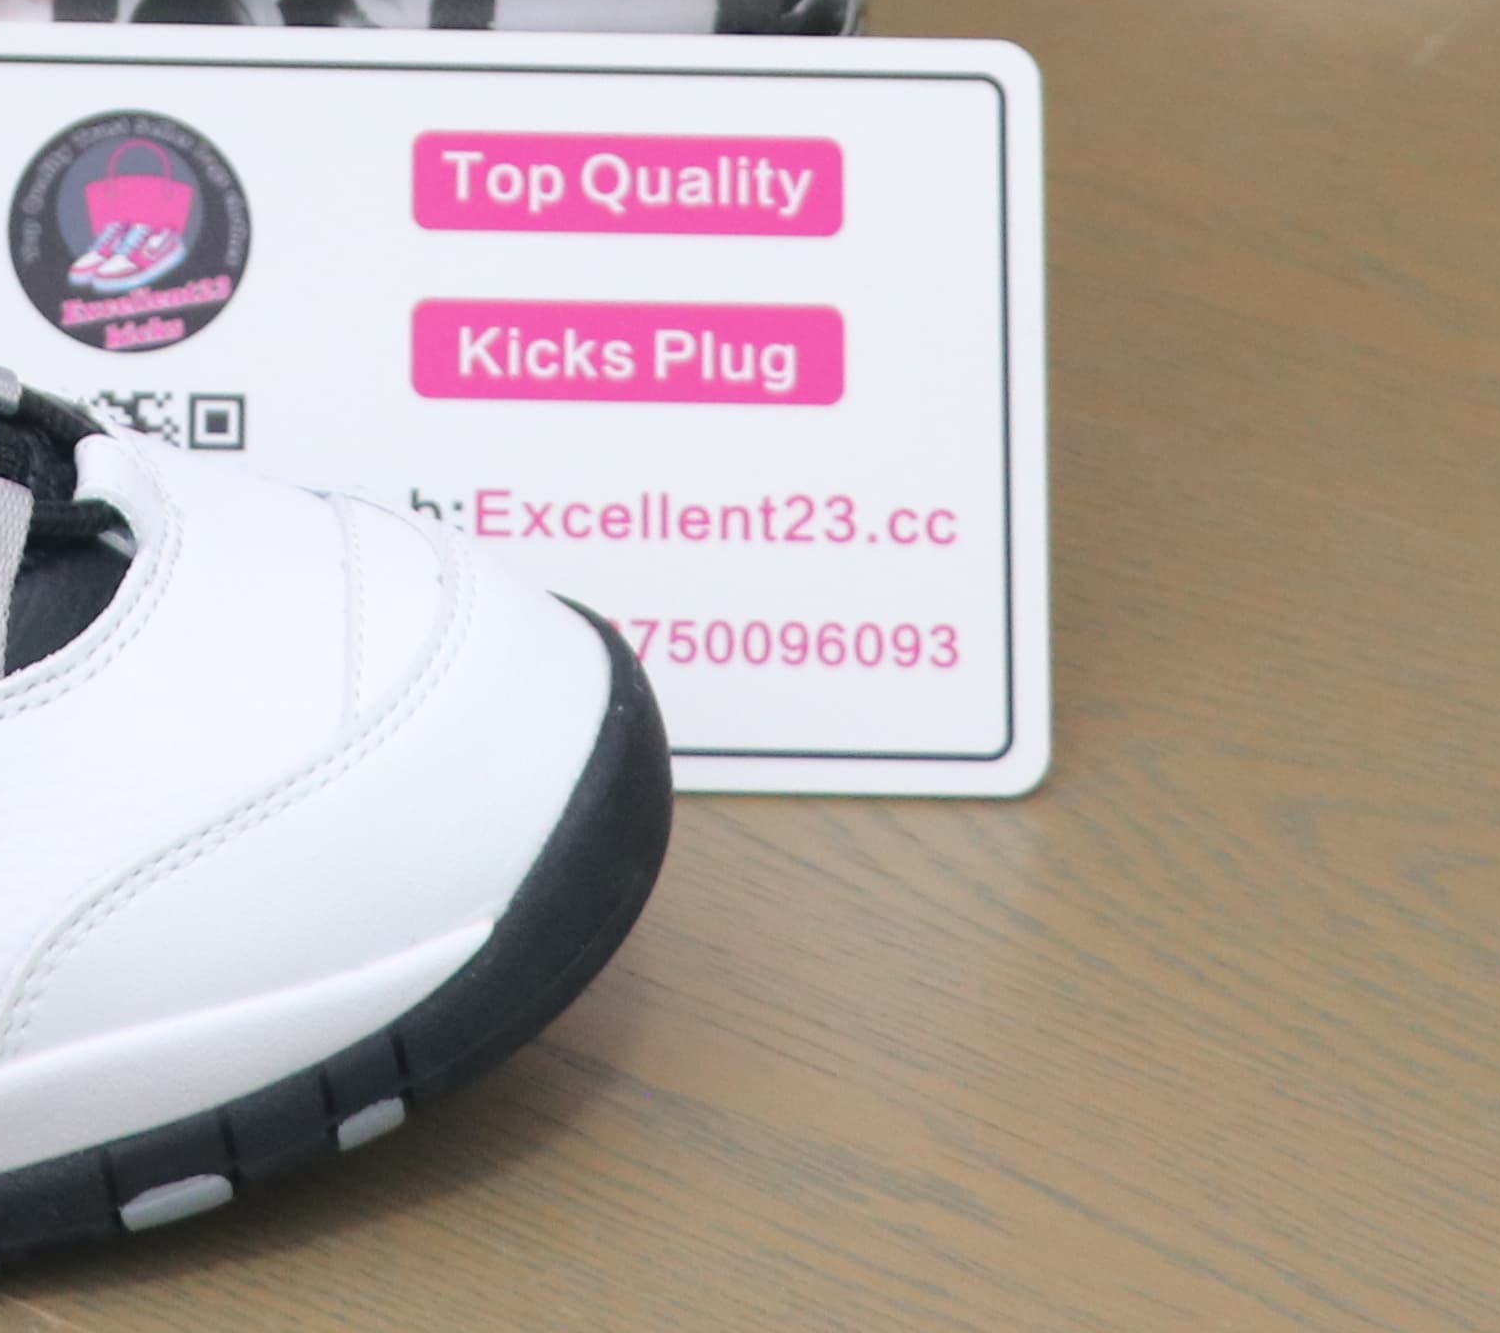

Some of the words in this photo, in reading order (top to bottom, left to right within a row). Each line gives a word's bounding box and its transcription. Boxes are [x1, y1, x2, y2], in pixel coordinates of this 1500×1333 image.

[442, 150, 565, 214] Top
[580, 151, 813, 218] Quality
[457, 325, 636, 381] Kicks
[653, 329, 798, 393] Plug
[606, 618, 961, 669] 750096093
